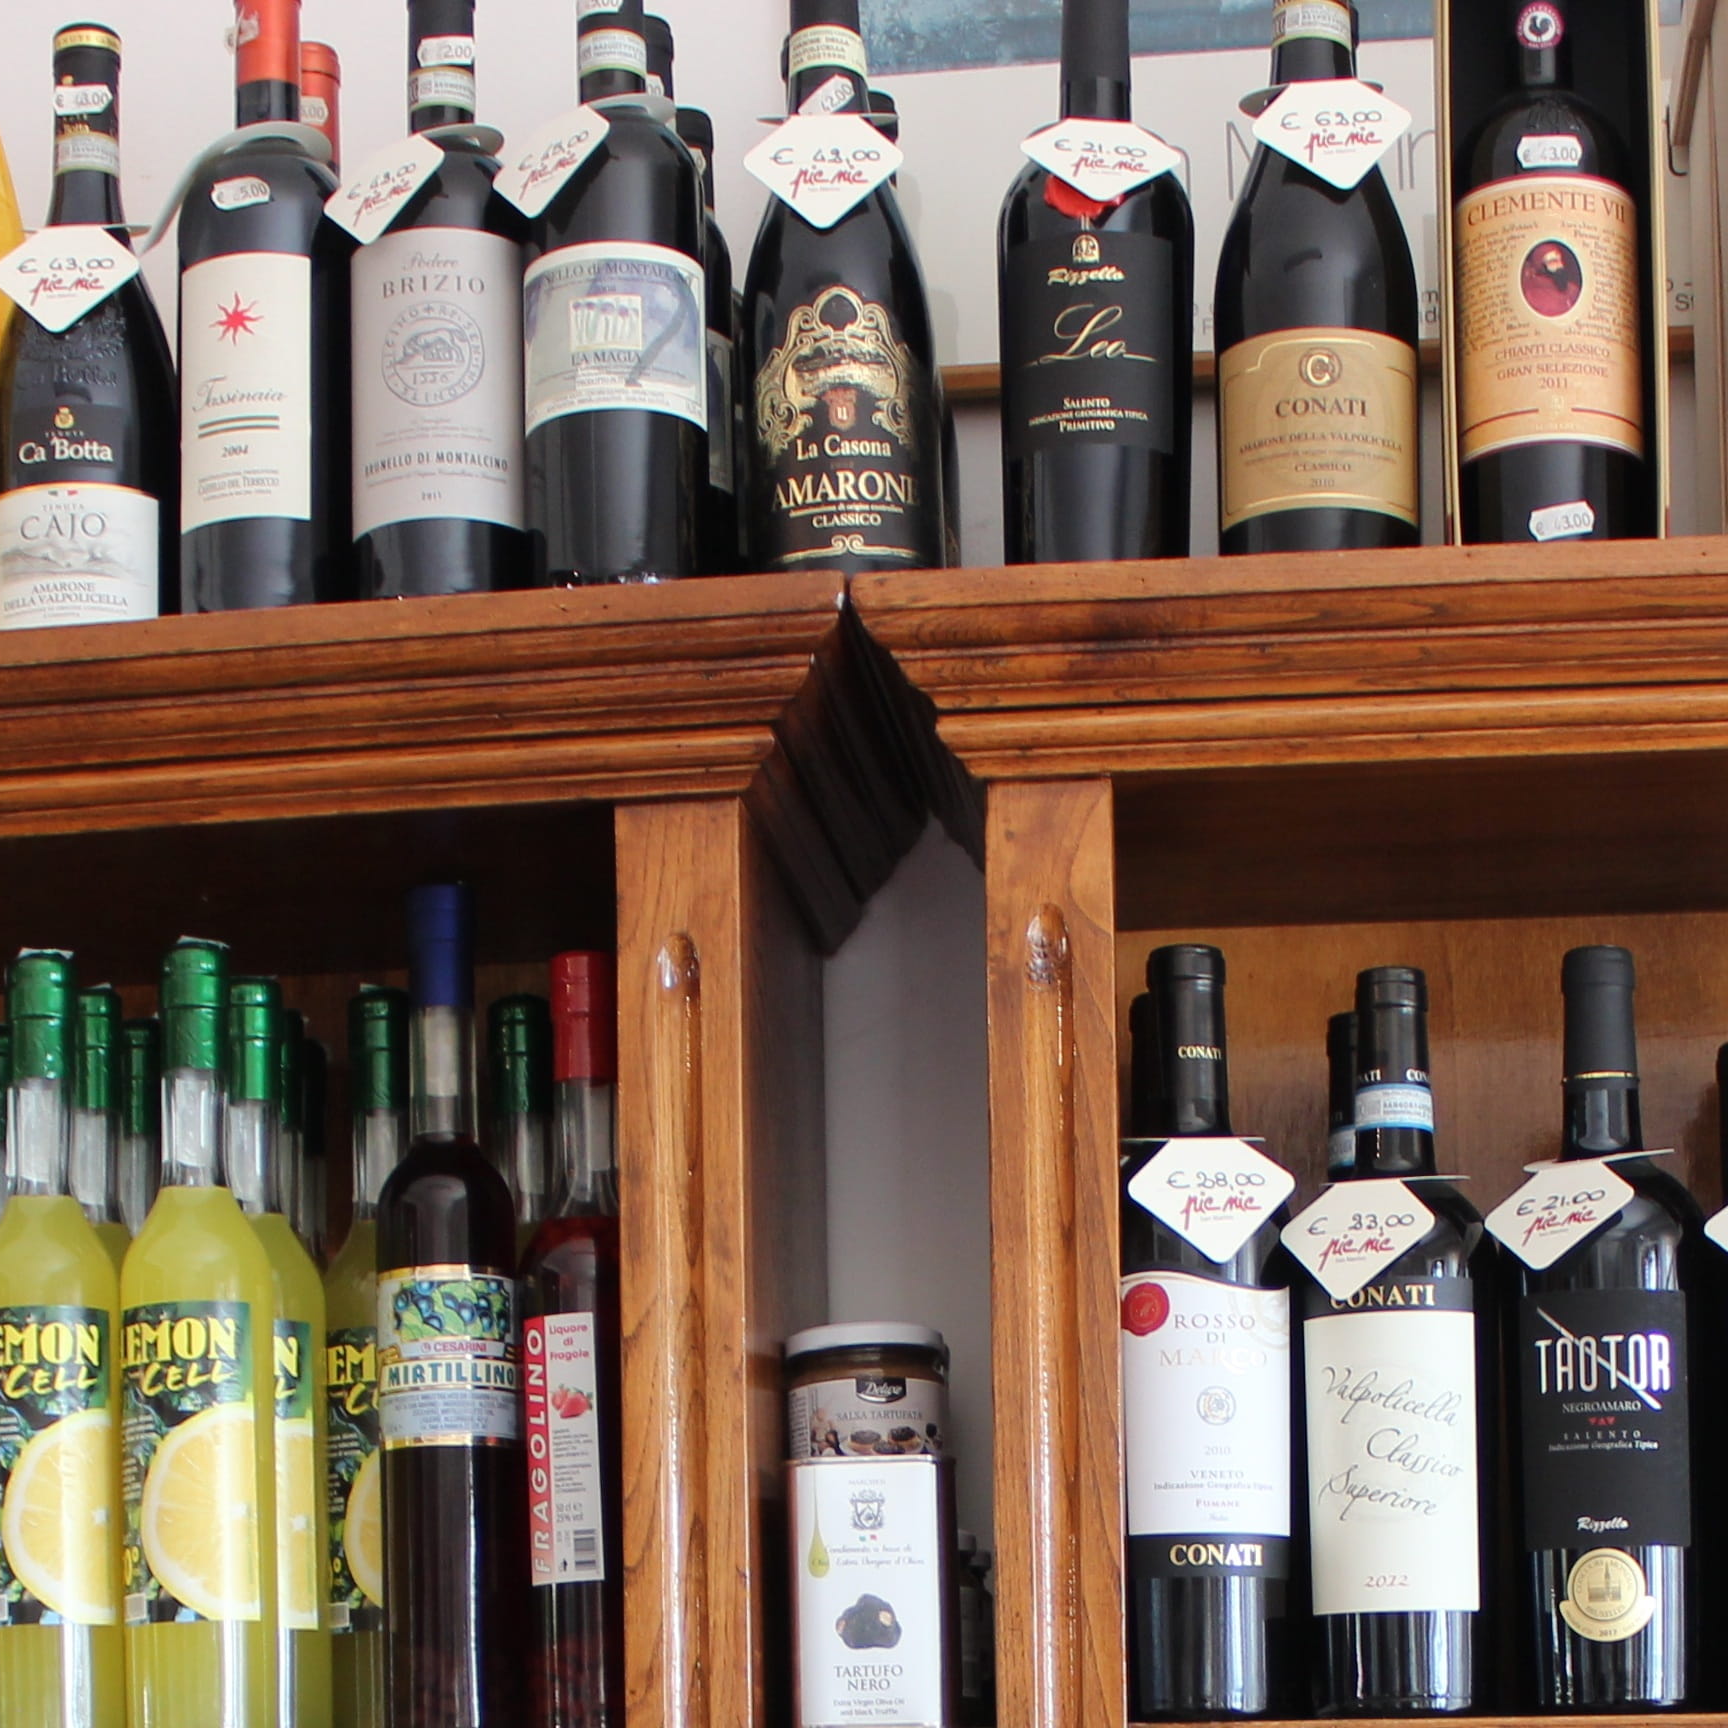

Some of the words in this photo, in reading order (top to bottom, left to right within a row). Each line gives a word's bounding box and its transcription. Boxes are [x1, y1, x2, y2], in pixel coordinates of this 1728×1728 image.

[1466, 190, 1596, 228] CLEMENTE
[381, 275, 486, 297] BRIZIO
[1275, 398, 1368, 421] CONATI
[796, 436, 819, 459] La
[824, 436, 893, 459] Casona
[417, 455, 432, 468] DI
[437, 453, 509, 471] MONTALCINO
[812, 512, 882, 529] CLASSICO
[548, 1322, 589, 1337] Liquore
[1174, 1312, 1256, 1331] ROSSO
[564, 1336, 574, 1347] di
[1207, 1331, 1227, 1344] DI
[549, 1347, 590, 1362] Fragola
[3, 1364, 97, 1400] CELL
[389, 1362, 516, 1387] MIRTILLINO
[1562, 1399, 1642, 1413] NEGROAMARO
[526, 1327, 554, 1575] FRAGOLINO
[1366, 1428, 1464, 1479] Classico
[1318, 1468, 1438, 1521] Superiore
[1170, 1543, 1263, 1567] CONATI
[1364, 1574, 1410, 1589] 2012
[834, 1664, 904, 1679] TARTUFO
[847, 1678, 891, 1691] NERO
